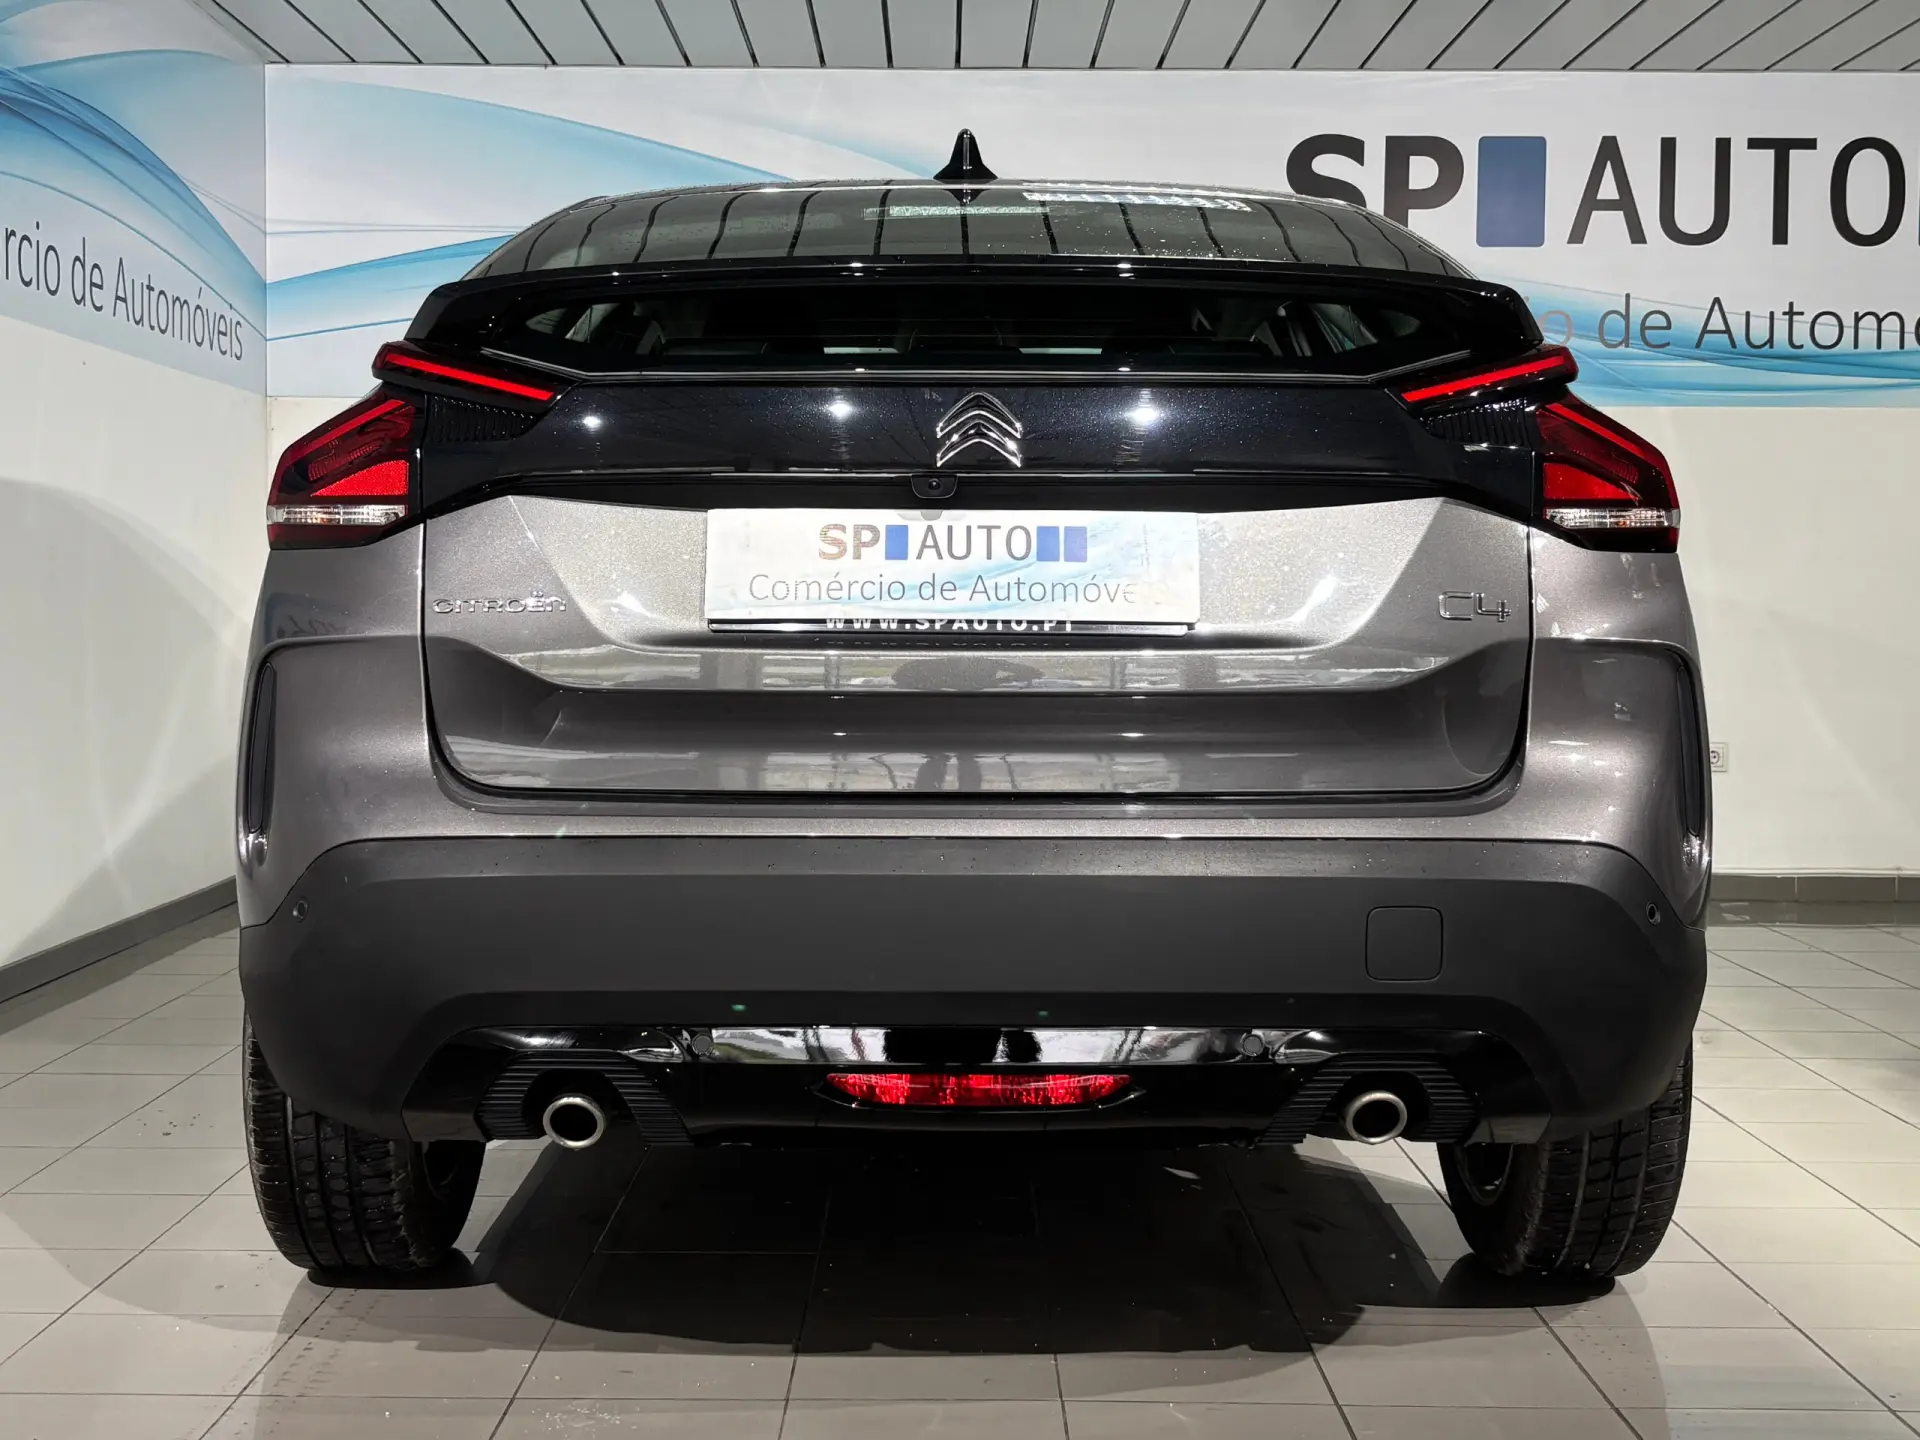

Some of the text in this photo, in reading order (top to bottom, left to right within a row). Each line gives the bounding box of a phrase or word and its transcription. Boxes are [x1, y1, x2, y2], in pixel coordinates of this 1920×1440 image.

[1286, 134, 1907, 247] SP AUTO
[71, 236, 104, 312] de
[113, 257, 243, 361] Automóveis
[1598, 292, 1672, 349] de
[1695, 297, 1920, 350] Autom
[818, 523, 1032, 561] SP AUTO
[749, 571, 906, 602] Comércio
[918, 573, 957, 602] de
[1438, 590, 1512, 622] C4
